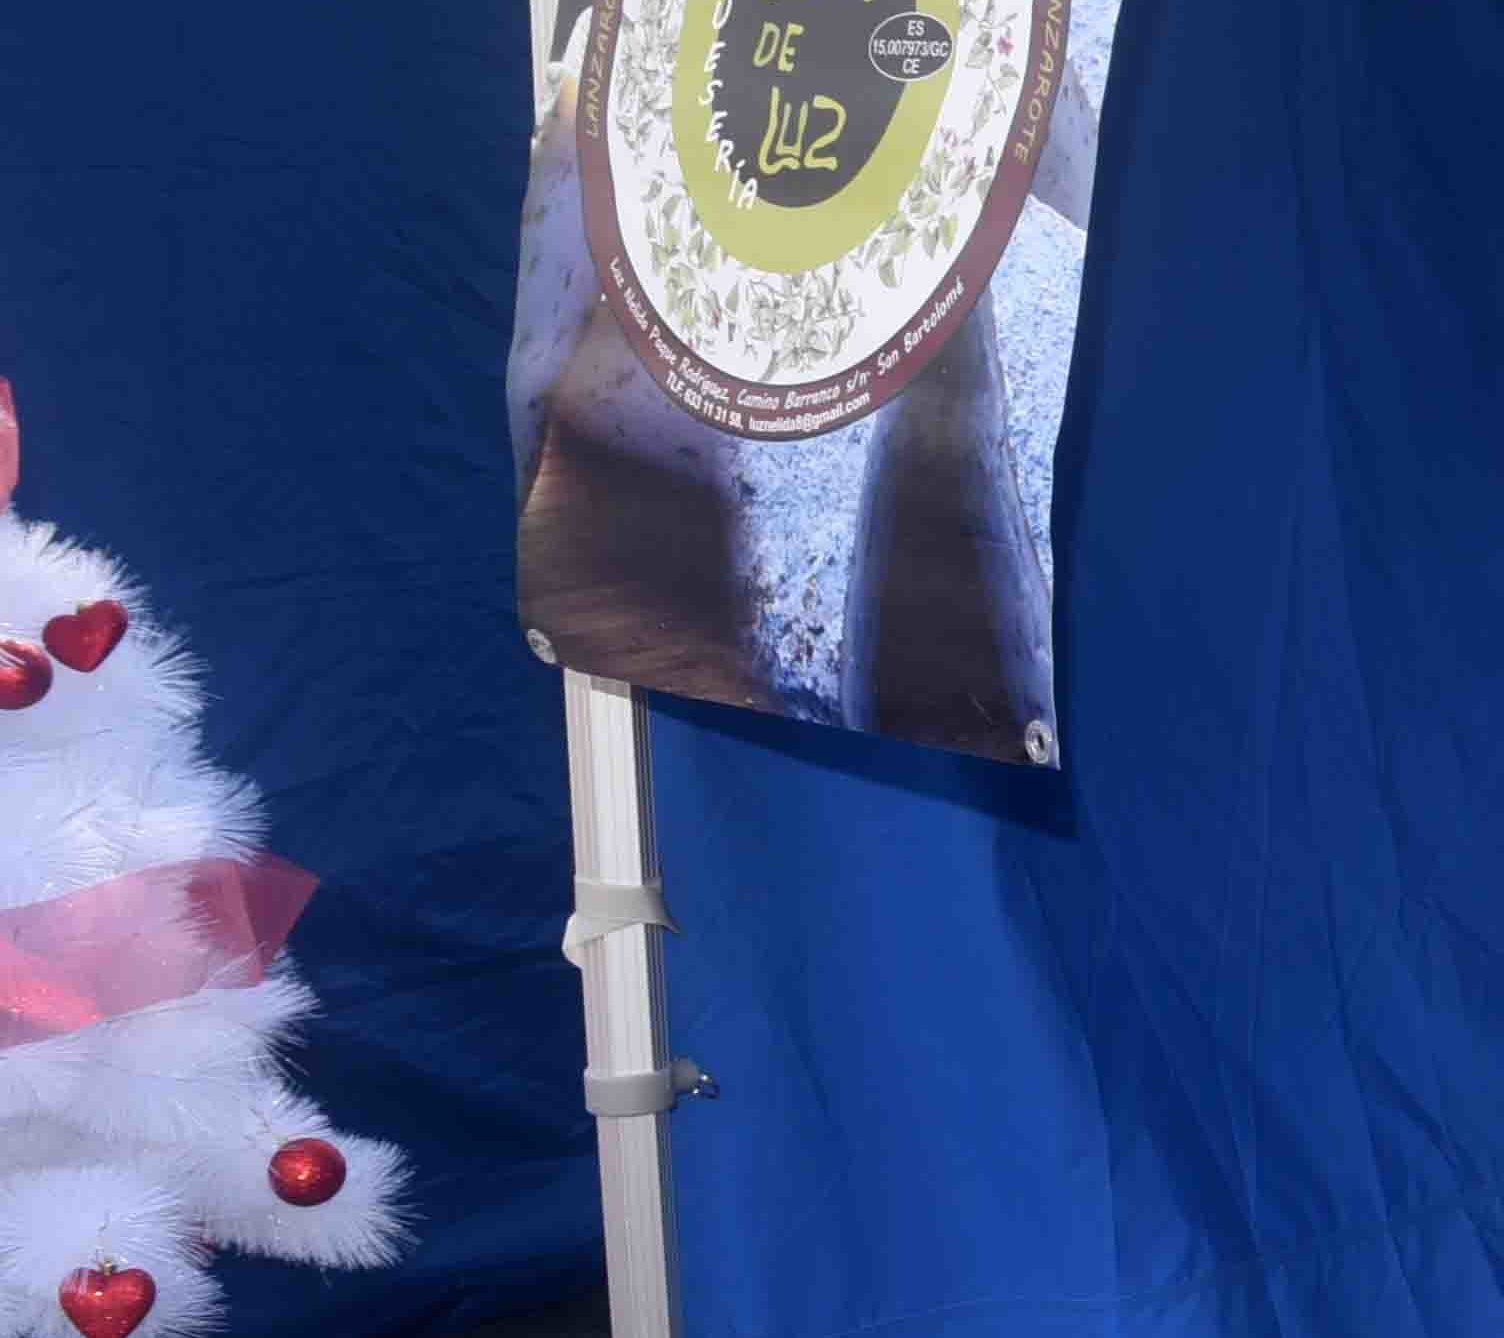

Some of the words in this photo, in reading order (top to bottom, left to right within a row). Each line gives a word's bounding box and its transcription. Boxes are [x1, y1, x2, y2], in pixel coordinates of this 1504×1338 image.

[907, 20, 925, 36] ES
[753, 21, 804, 72] DE
[902, 59, 920, 74] CE
[759, 86, 847, 175] LUZ
